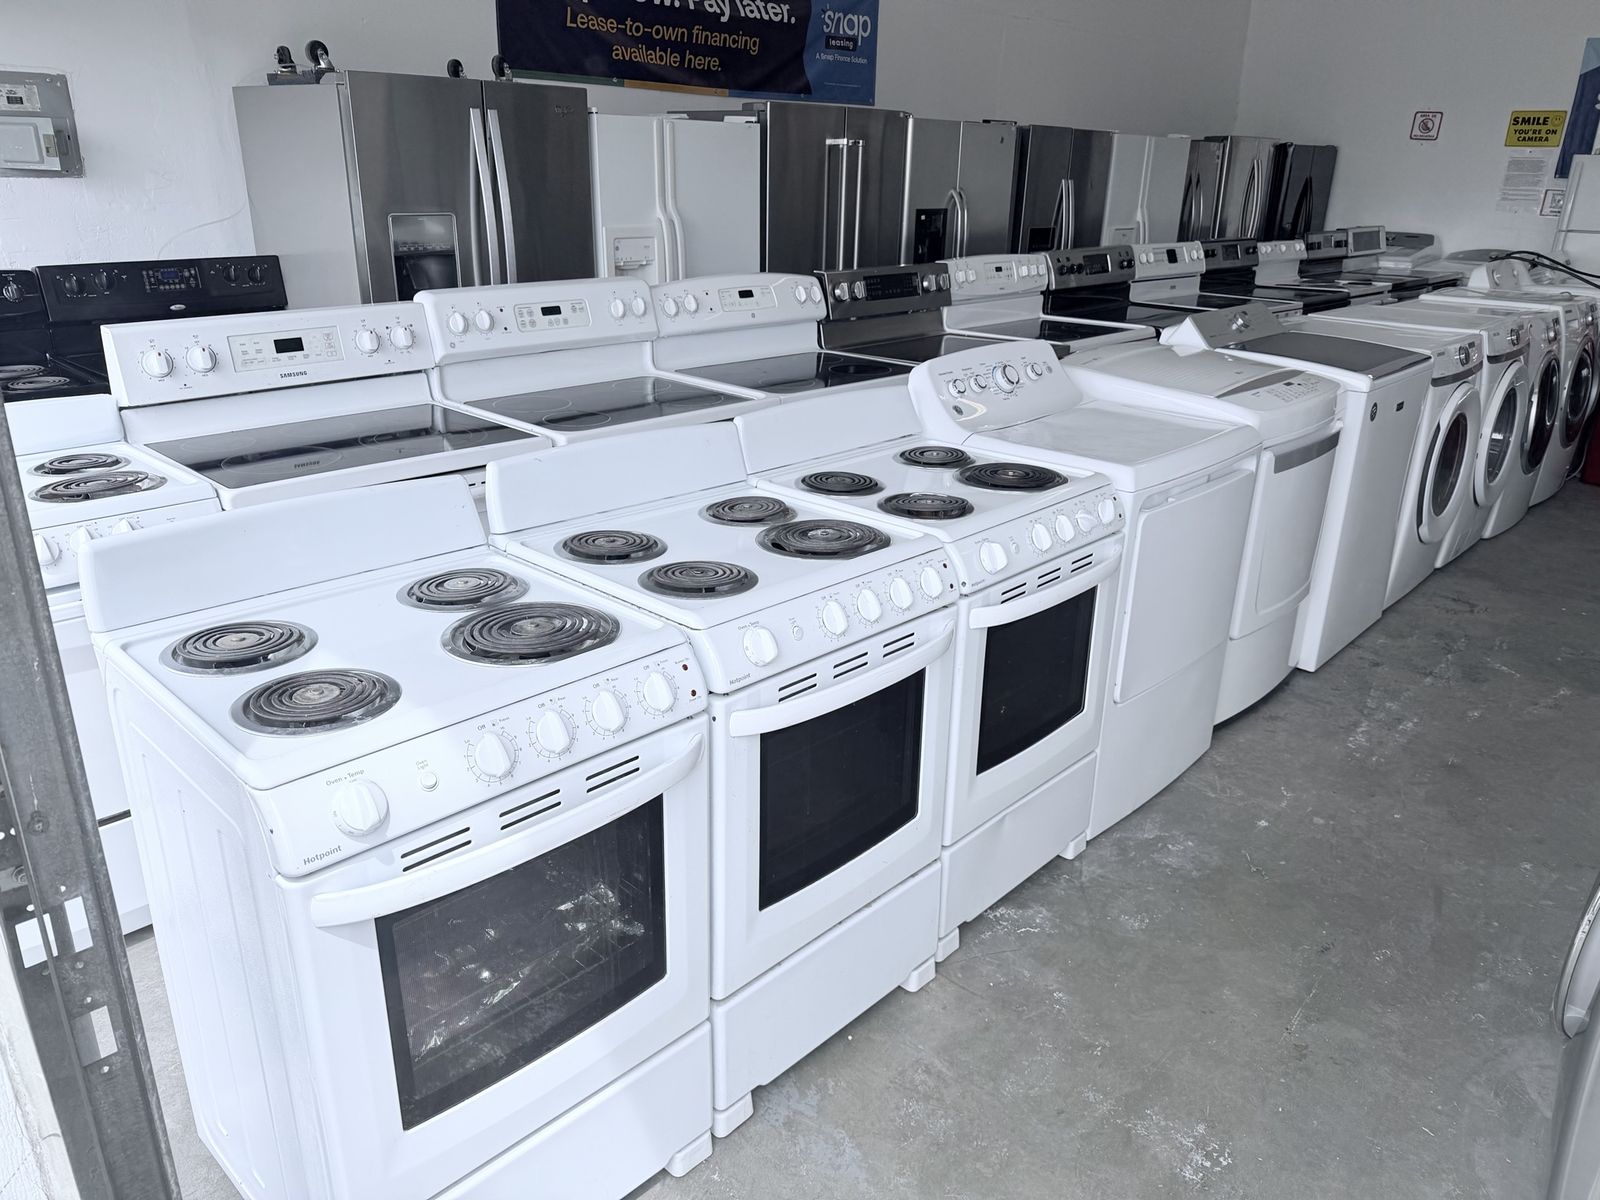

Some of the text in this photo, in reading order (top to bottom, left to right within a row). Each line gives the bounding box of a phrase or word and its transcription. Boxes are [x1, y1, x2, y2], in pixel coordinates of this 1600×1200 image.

[737, 0, 796, 24] later.
[566, 7, 760, 55] Lease-to-own financing
[823, 10, 871, 46] snap
[829, 38, 854, 50] leasing
[612, 44, 722, 71] available here.
[1512, 116, 1550, 126] SMILE
[280, 370, 308, 379] SAMSUNG
[325, 777, 343, 786] Oven
[347, 769, 365, 779] Temp
[303, 845, 341, 865] Hotpoint
